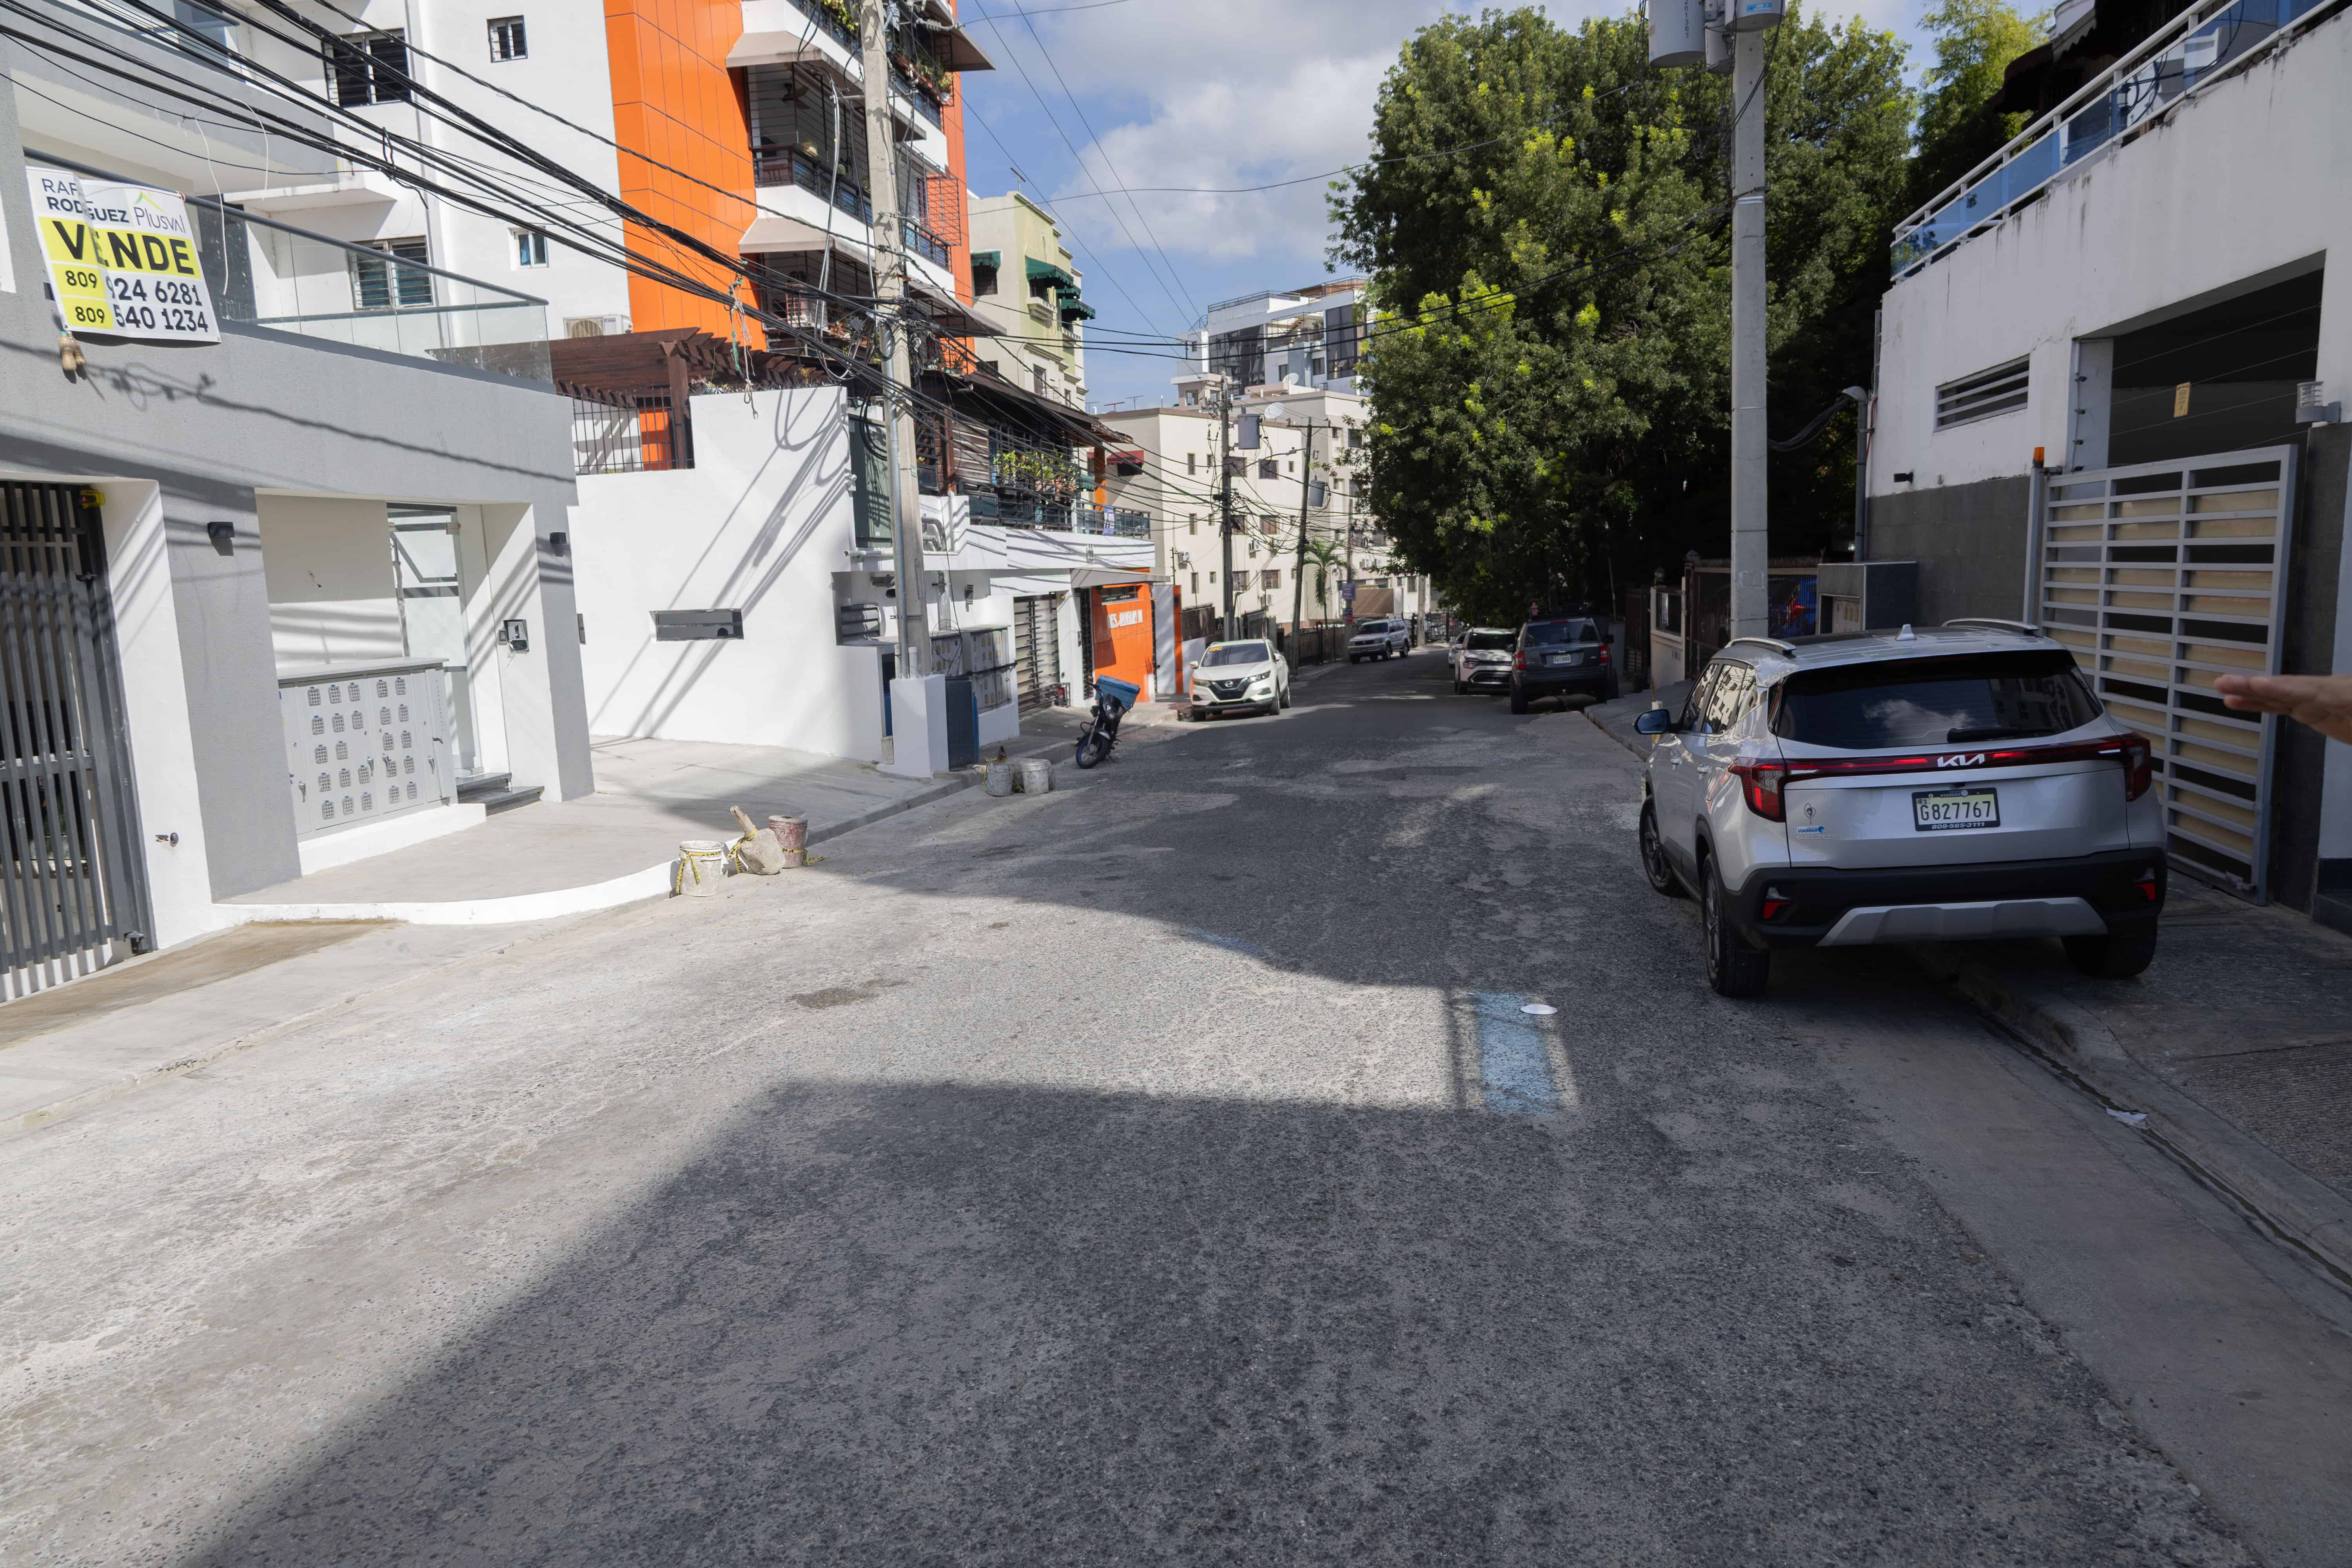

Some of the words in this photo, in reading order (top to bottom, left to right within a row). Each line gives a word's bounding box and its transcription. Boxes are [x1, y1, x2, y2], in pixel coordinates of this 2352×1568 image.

[46, 196, 130, 223] RODGUEZ
[65, 270, 97, 289] 809
[106, 276, 147, 301] 924
[155, 281, 203, 307] 6281
[75, 306, 105, 324] 809
[113, 304, 156, 329] 540
[161, 308, 209, 333] 1234
[1937, 754, 1985, 767] KIA
[1920, 800, 1991, 821] G827767
